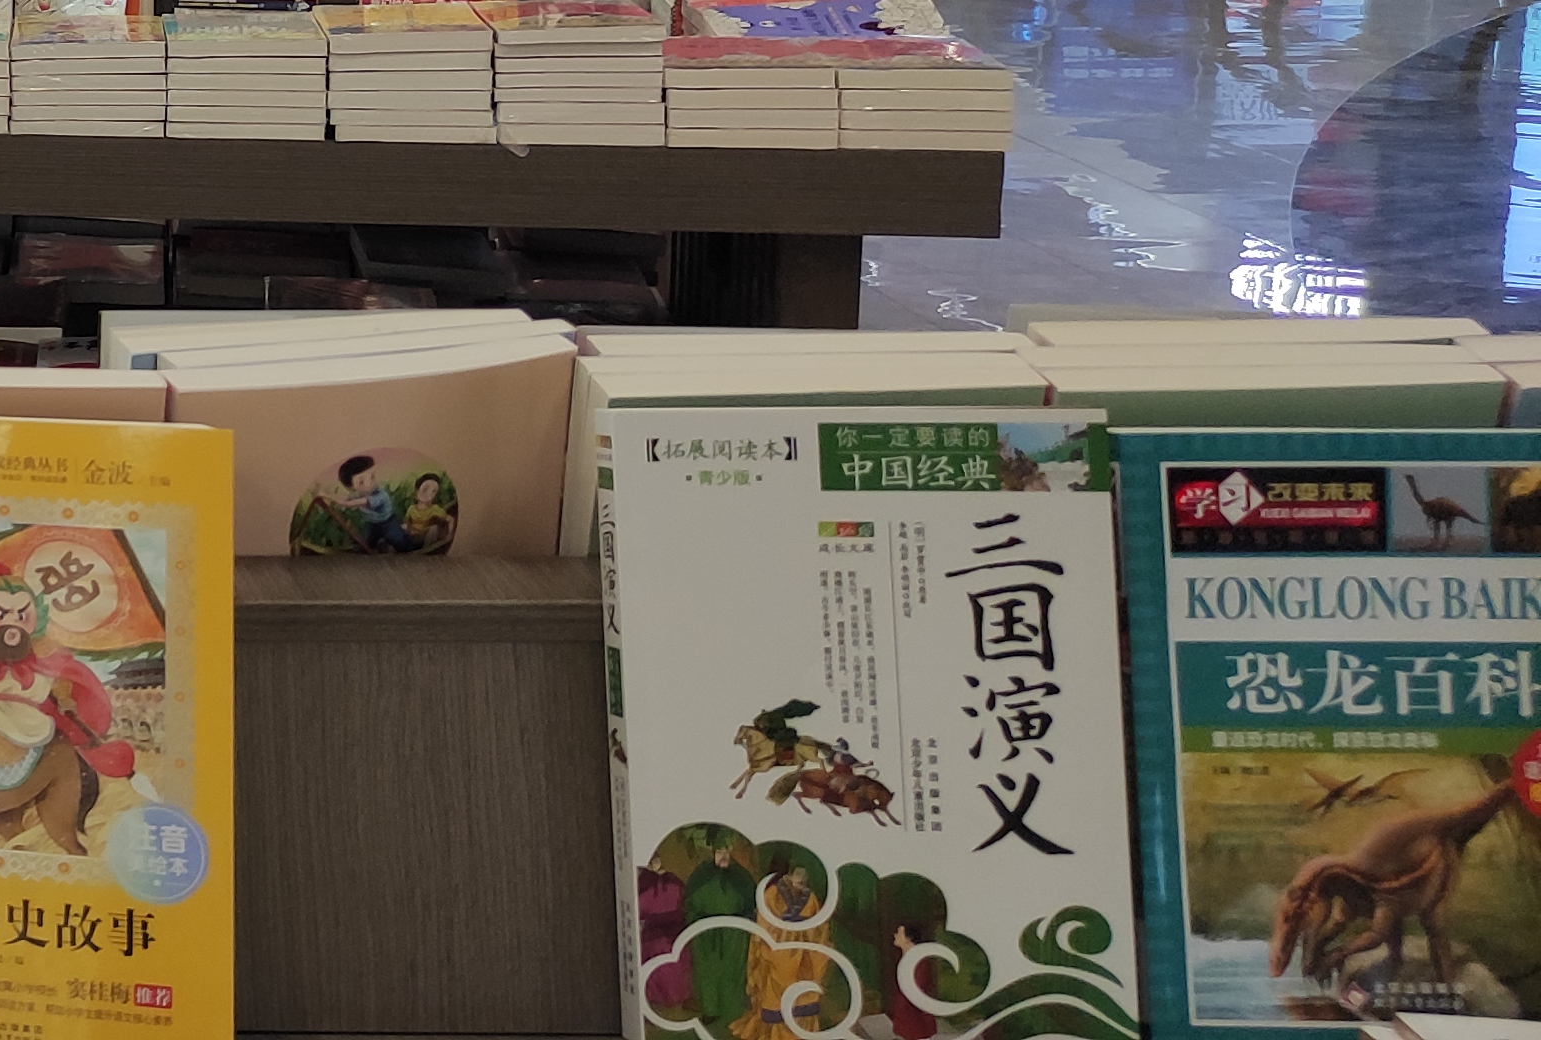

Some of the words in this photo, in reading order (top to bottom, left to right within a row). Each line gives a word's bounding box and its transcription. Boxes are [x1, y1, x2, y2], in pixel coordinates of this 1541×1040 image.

[836, 426, 990, 448] 你一定要读的
[81, 459, 134, 487] 金波
[698, 468, 751, 487] 青少版
[841, 453, 997, 491] 中国经典
[1179, 478, 1257, 522] 学习
[1265, 483, 1376, 502] 改变未来
[1185, 576, 1430, 620] KONGLONG
[945, 512, 1075, 854] 三国演义
[1225, 649, 1541, 718] 恐龙百科
[137, 985, 172, 1008] 推荐
